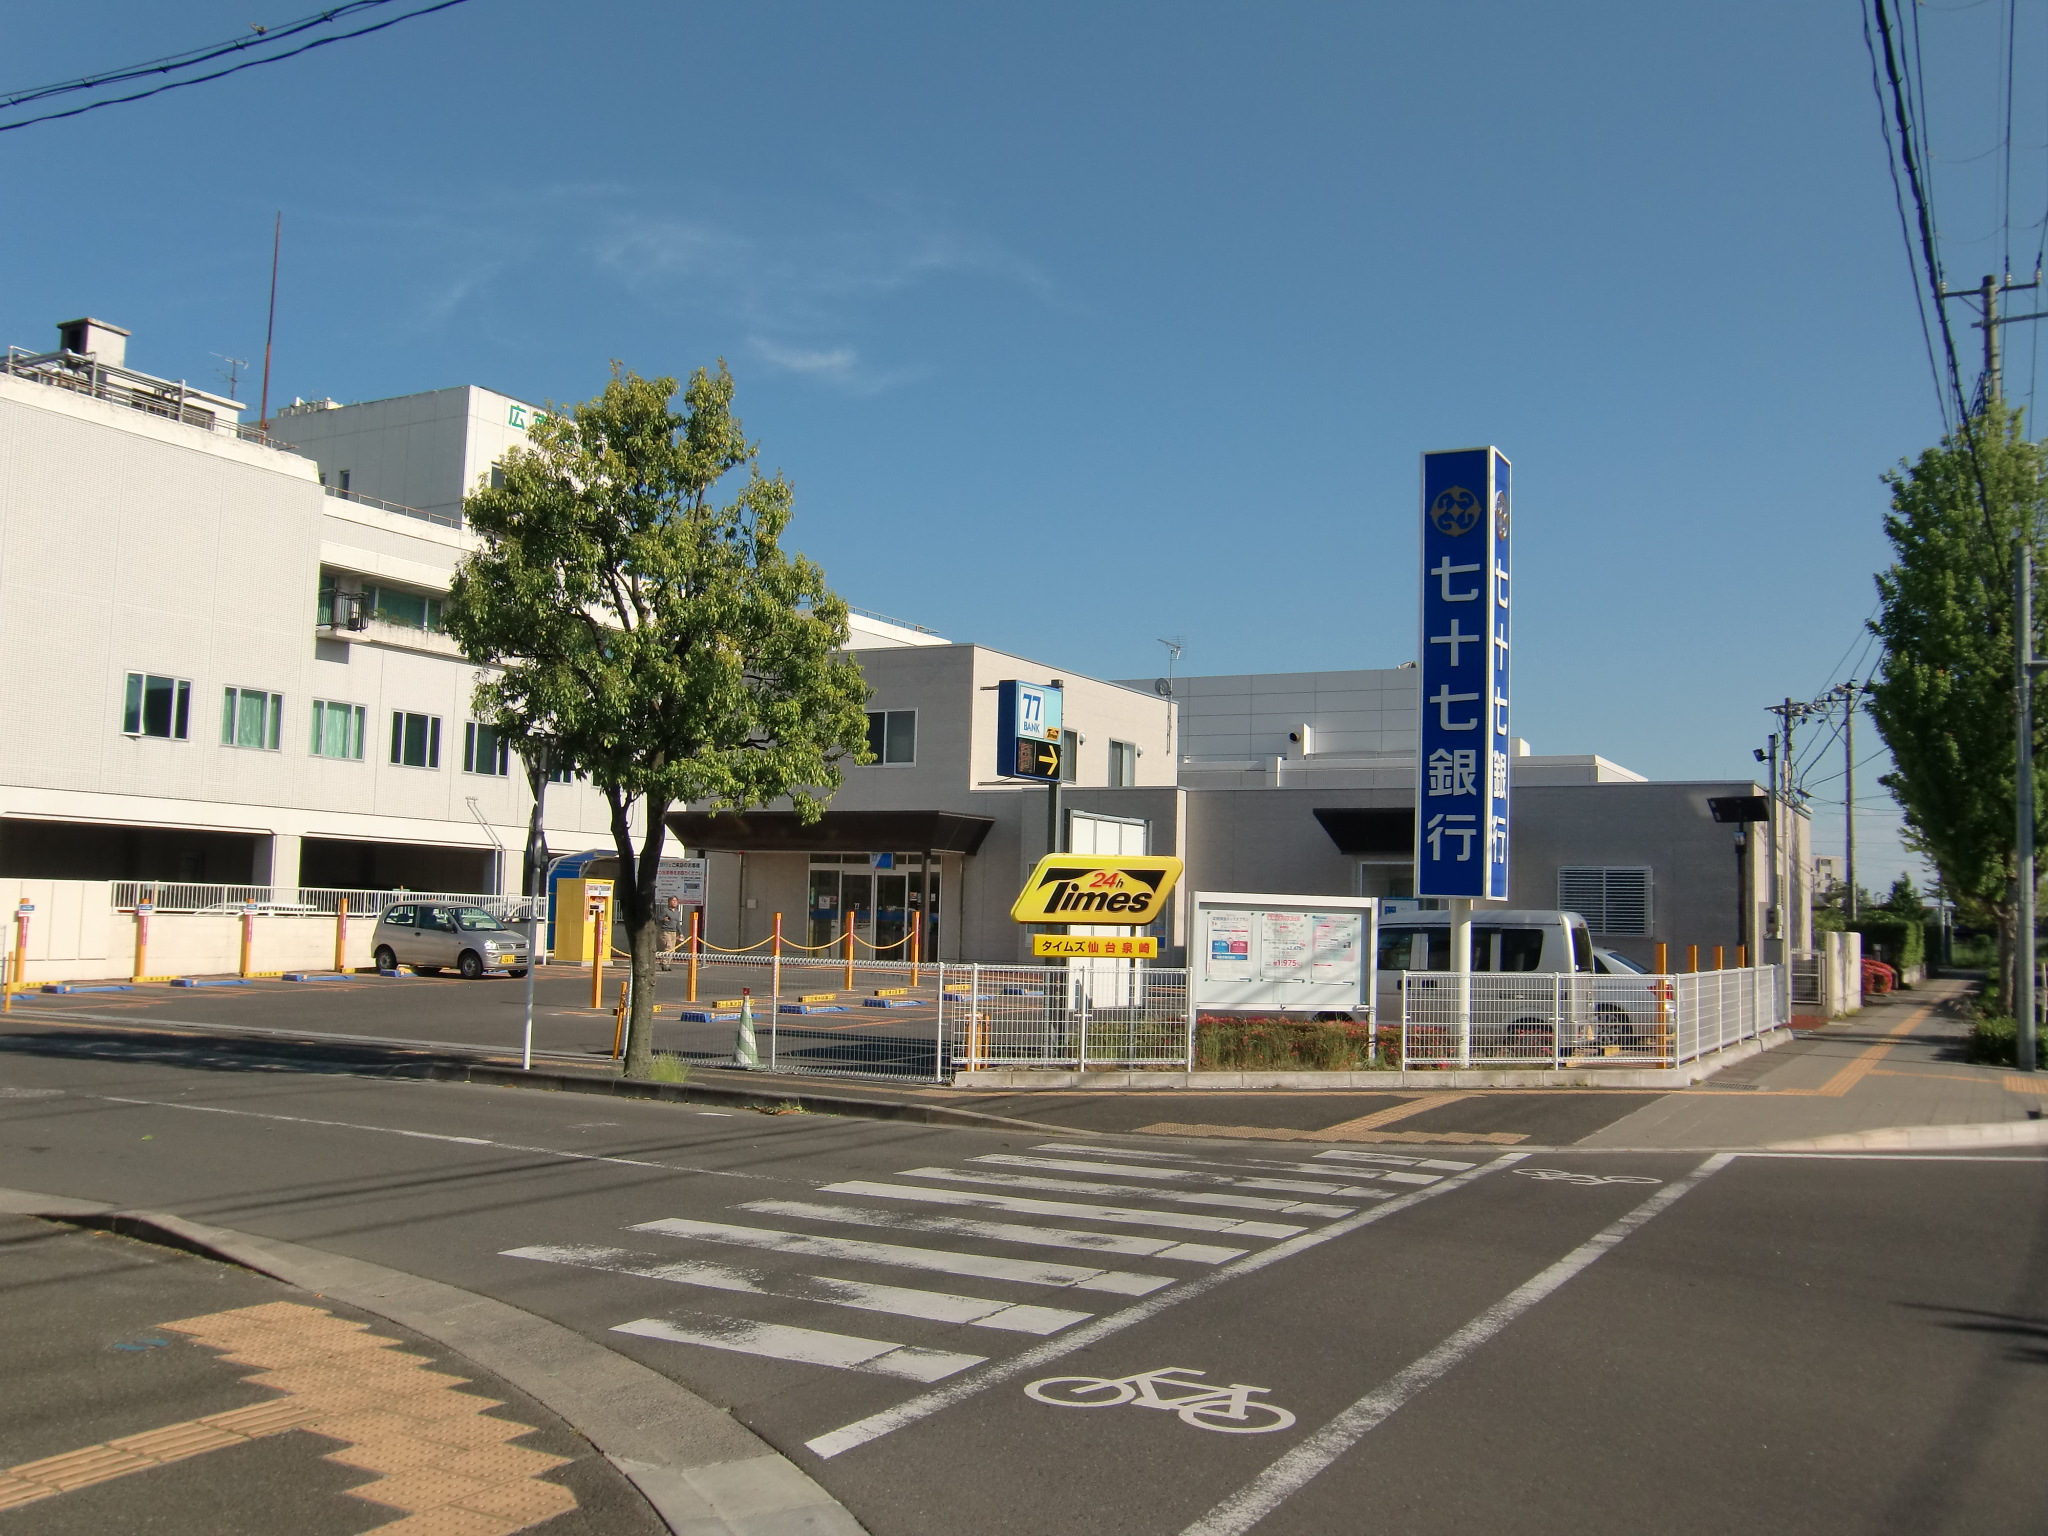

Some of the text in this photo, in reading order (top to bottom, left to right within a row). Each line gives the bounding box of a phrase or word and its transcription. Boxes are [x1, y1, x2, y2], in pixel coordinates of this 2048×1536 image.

[1023, 693, 1041, 721] 77
[1427, 555, 1481, 862] 七十七銀行
[1491, 558, 1509, 864] 七十七銀行
[1023, 721, 1040, 733] BANK
[1042, 878, 1153, 914] Times
[1089, 872, 1124, 889] 24h
